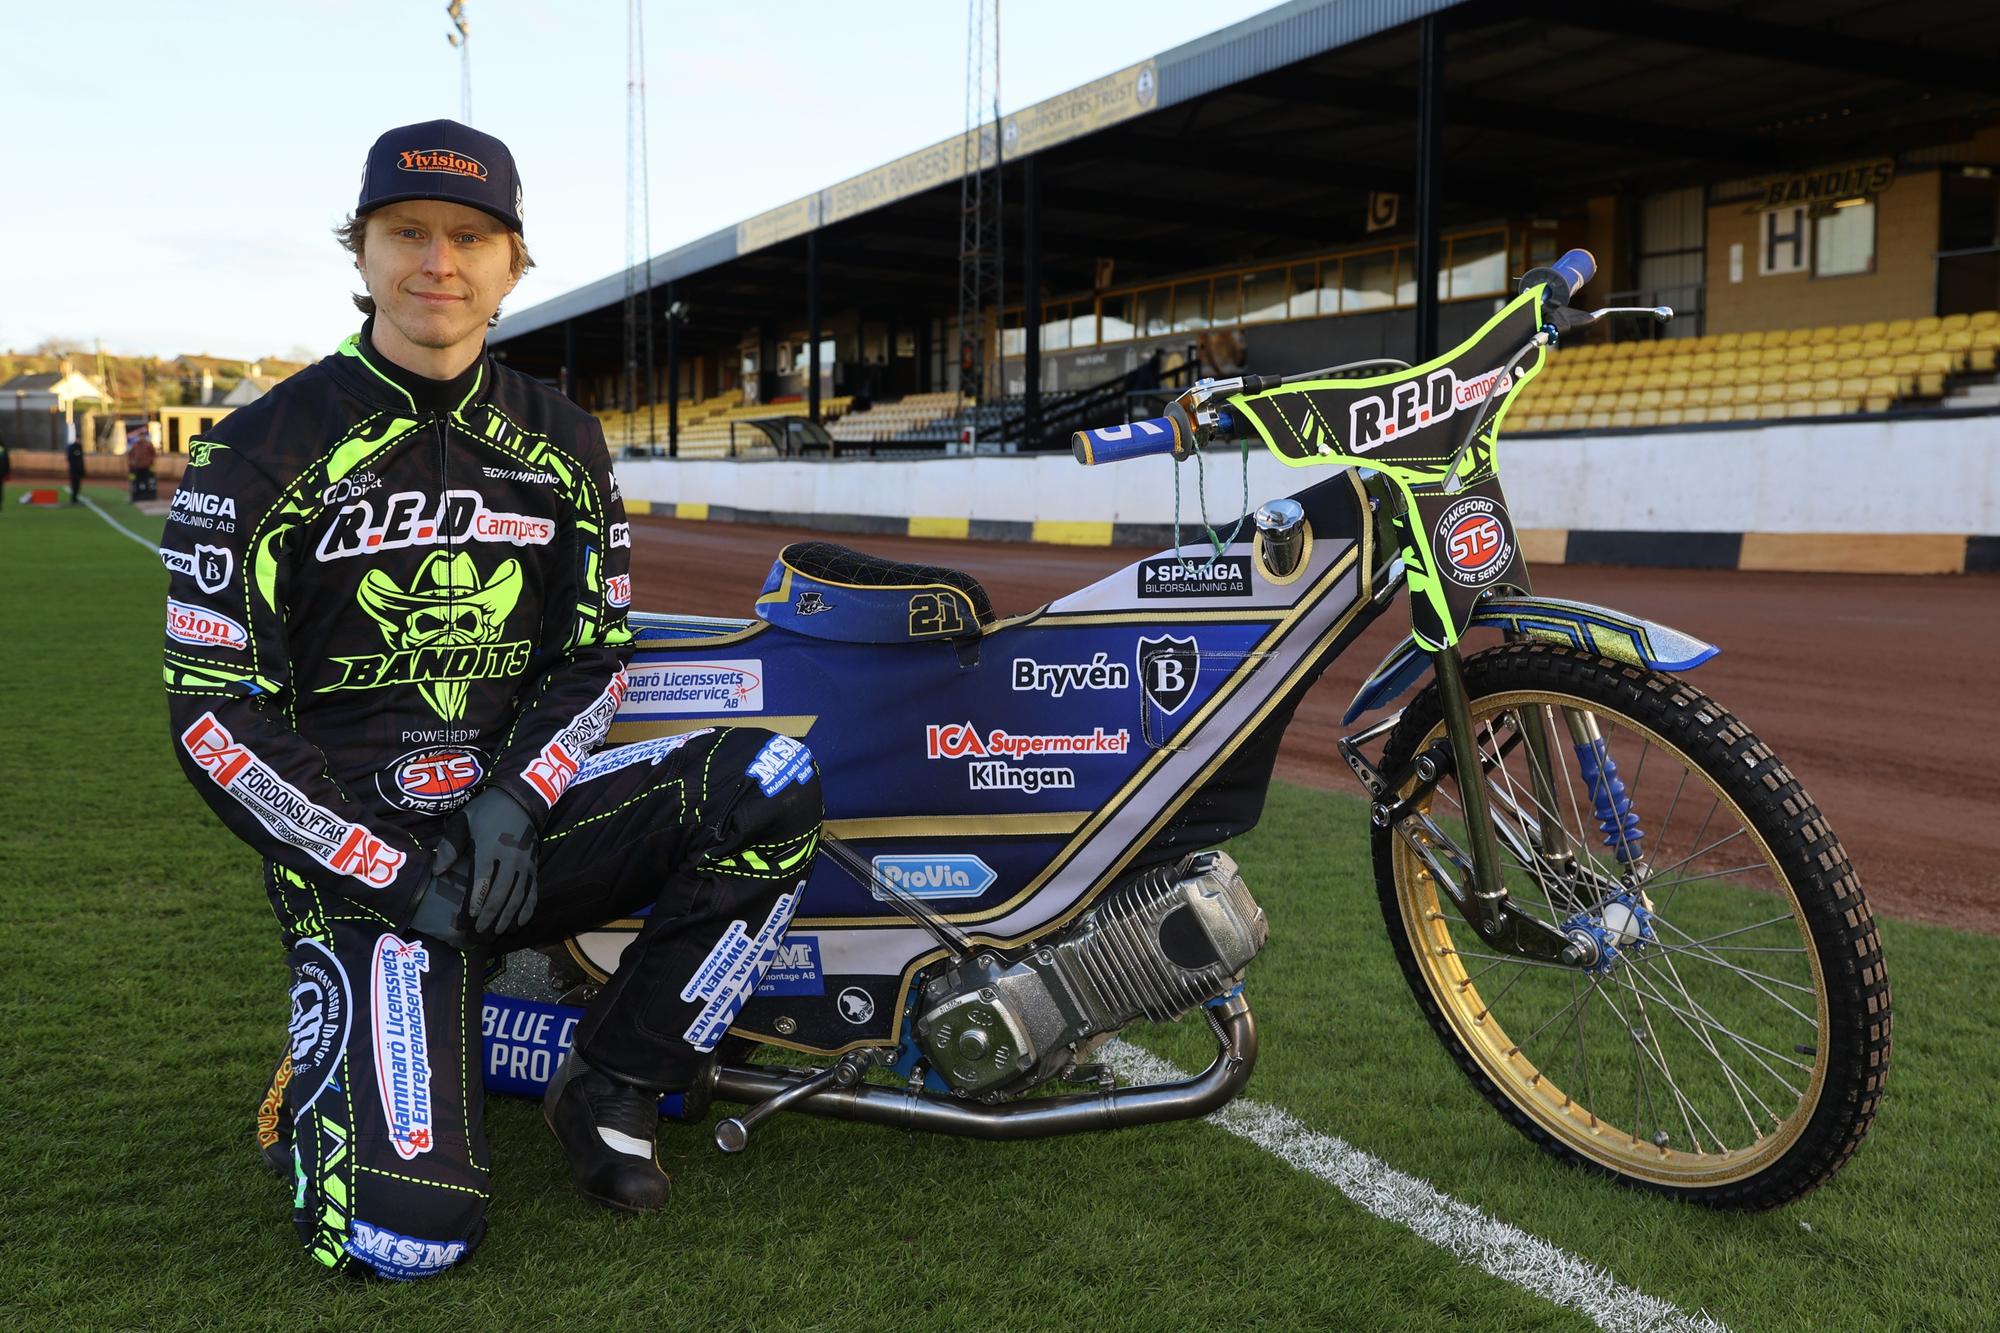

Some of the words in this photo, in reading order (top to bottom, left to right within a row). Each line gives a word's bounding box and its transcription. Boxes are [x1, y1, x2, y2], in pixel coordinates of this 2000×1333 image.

[1095, 81, 1134, 114] TRUST
[400, 150, 479, 174] Ytvision
[1767, 162, 1892, 204] BANDITS
[1766, 208, 1804, 271] H
[1356, 375, 1452, 447] R.E.D
[1455, 374, 1510, 404] Campes
[352, 470, 376, 484] Cab
[216, 520, 236, 533] AB
[322, 495, 478, 556] R.E.D
[475, 514, 549, 541] Campers
[1439, 500, 1494, 539] STAKEFORD
[1449, 519, 1499, 564] STS
[1157, 559, 1243, 582] SPÅNGA
[1452, 568, 1476, 583] TYRE
[1477, 542, 1512, 582] SERVICES
[1229, 581, 1244, 592] AB
[909, 592, 964, 637] 21
[335, 640, 532, 690] BANDITS
[663, 671, 744, 687] Licenssvets
[1015, 655, 1127, 695] Bryvén
[1153, 658, 1187, 692] B
[723, 698, 739, 709] AB
[401, 729, 468, 743] POWERED
[468, 728, 481, 740] BY
[928, 722, 985, 757] ICA
[989, 729, 1127, 759] Supermarket
[402, 756, 475, 790] STS
[972, 763, 1073, 792] Klingan
[240, 765, 348, 842] FORDONSLYFTAR
[399, 795, 437, 811] TYRE
[883, 864, 970, 888] ProVia
[413, 950, 427, 969] AB
[729, 897, 791, 983] INDUSTRIAL
[685, 923, 742, 999] www.svizza.com
[701, 936, 749, 998] SWEDEN
[802, 971, 816, 980] AB
[382, 949, 406, 1037] Licenssvets
[481, 1005, 555, 1045] BLUE
[688, 985, 734, 1042] SERVICE
[401, 961, 429, 1126] Entreprenadservice
[386, 1042, 411, 1143] Hammarö
[408, 1128, 430, 1149] &
[353, 1222, 464, 1269] MSM
[397, 1268, 404, 1276] &
